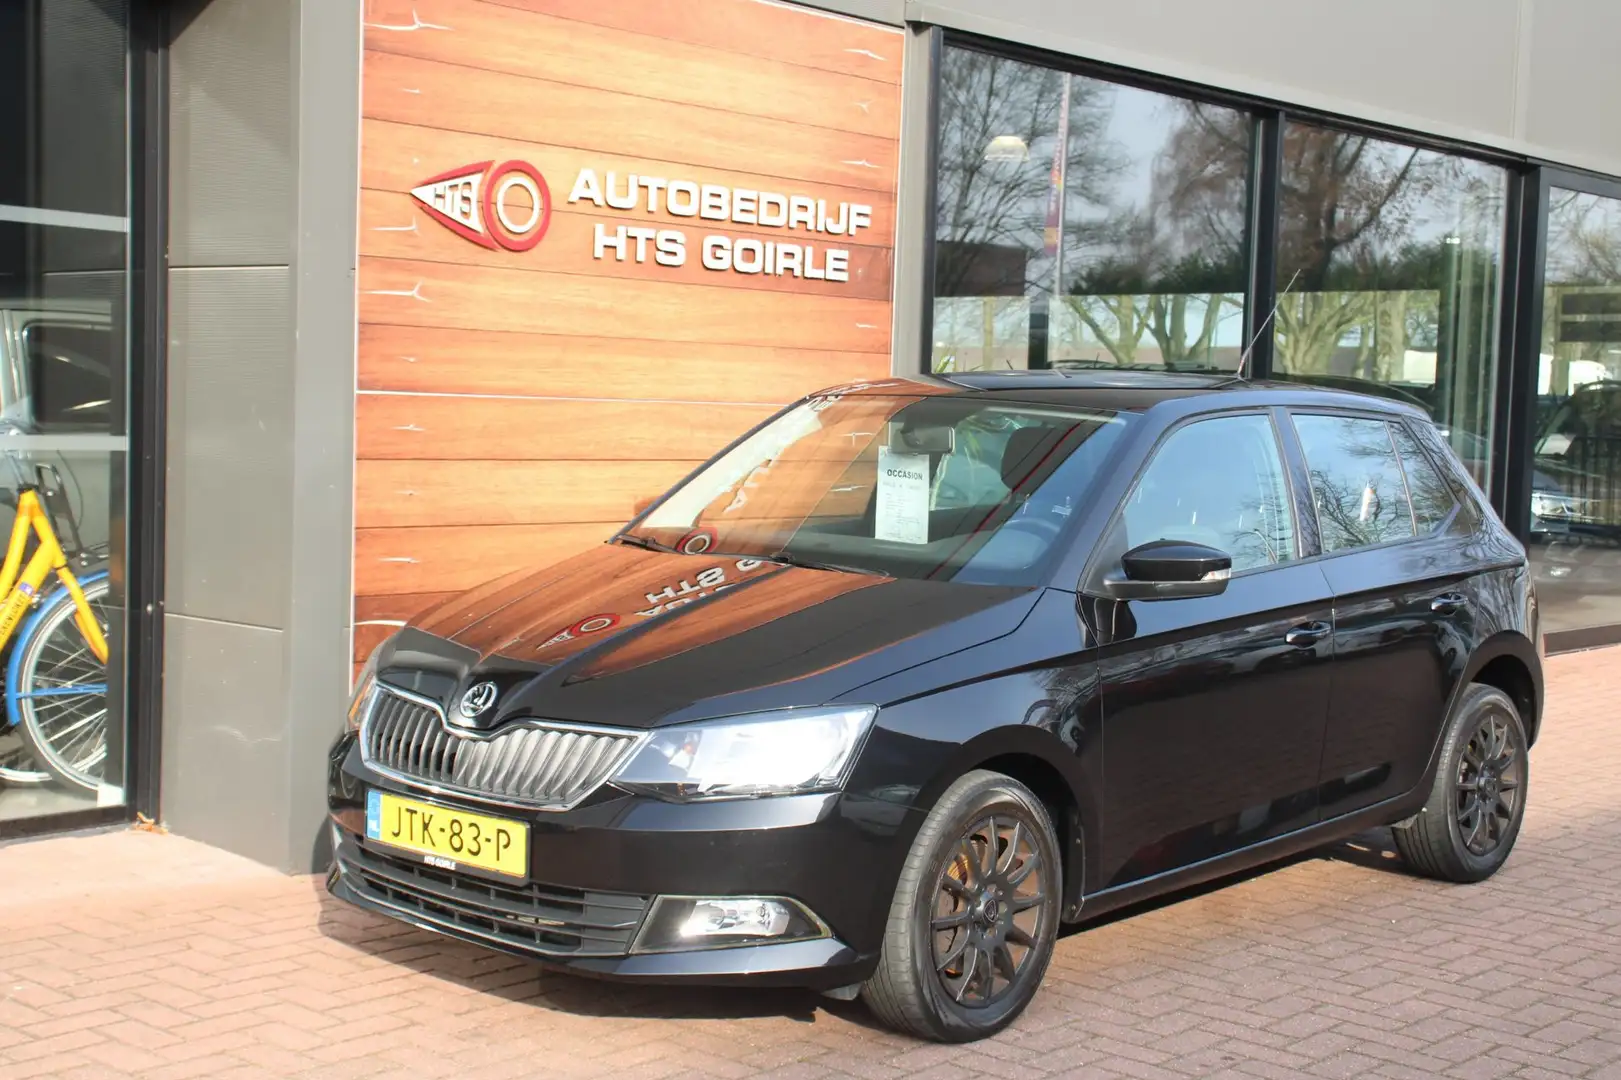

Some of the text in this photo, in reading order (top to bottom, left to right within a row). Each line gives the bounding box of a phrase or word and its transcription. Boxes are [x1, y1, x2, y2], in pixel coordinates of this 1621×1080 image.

[433, 181, 472, 220] HTS
[568, 168, 873, 236] AUTOBEDRIJF
[593, 224, 849, 282] HTS GOIRLE
[886, 468, 923, 480] OCCASION
[392, 806, 511, 862] JTK-83-P
